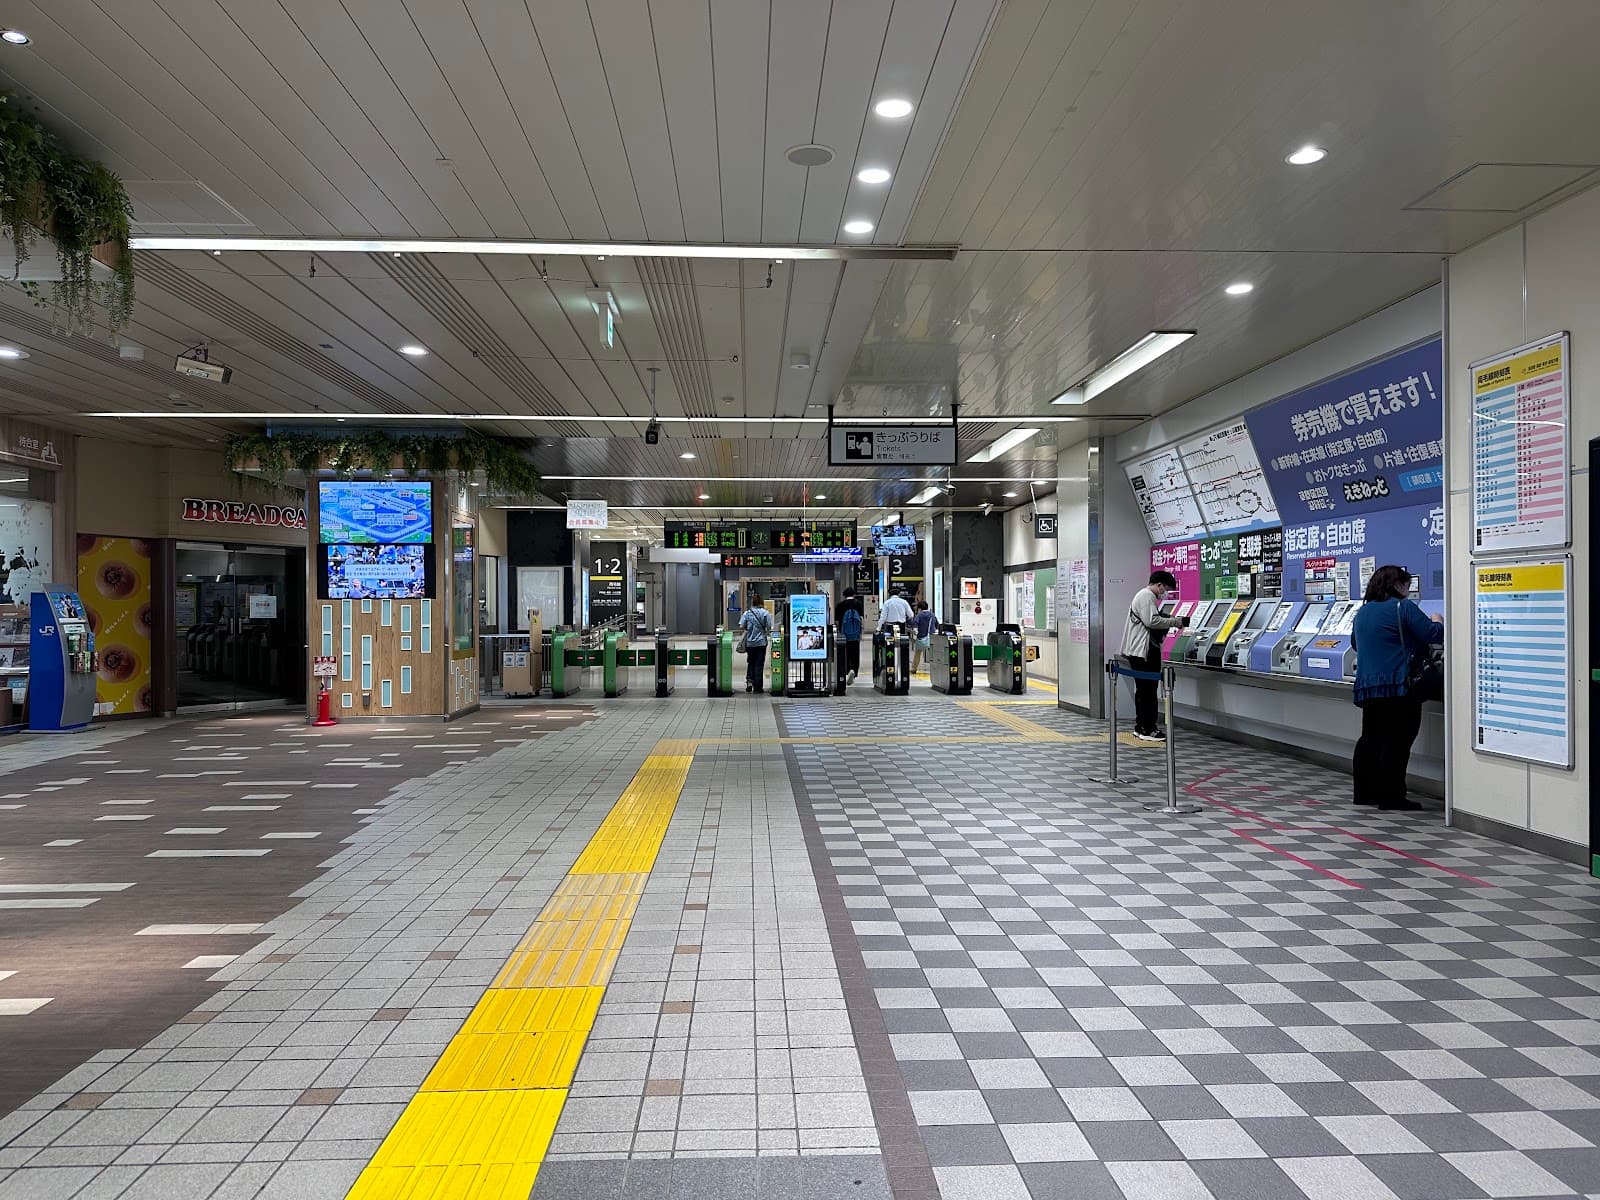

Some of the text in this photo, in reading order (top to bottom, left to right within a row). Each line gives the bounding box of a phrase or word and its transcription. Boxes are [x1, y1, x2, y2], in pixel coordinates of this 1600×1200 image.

[876, 431, 941, 443] きっぷうりば
[1344, 478, 1389, 502] えきねっと
[1200, 540, 1221, 562] きっぷ
[892, 559, 902, 575] 3
[39, 625, 55, 634] JR
